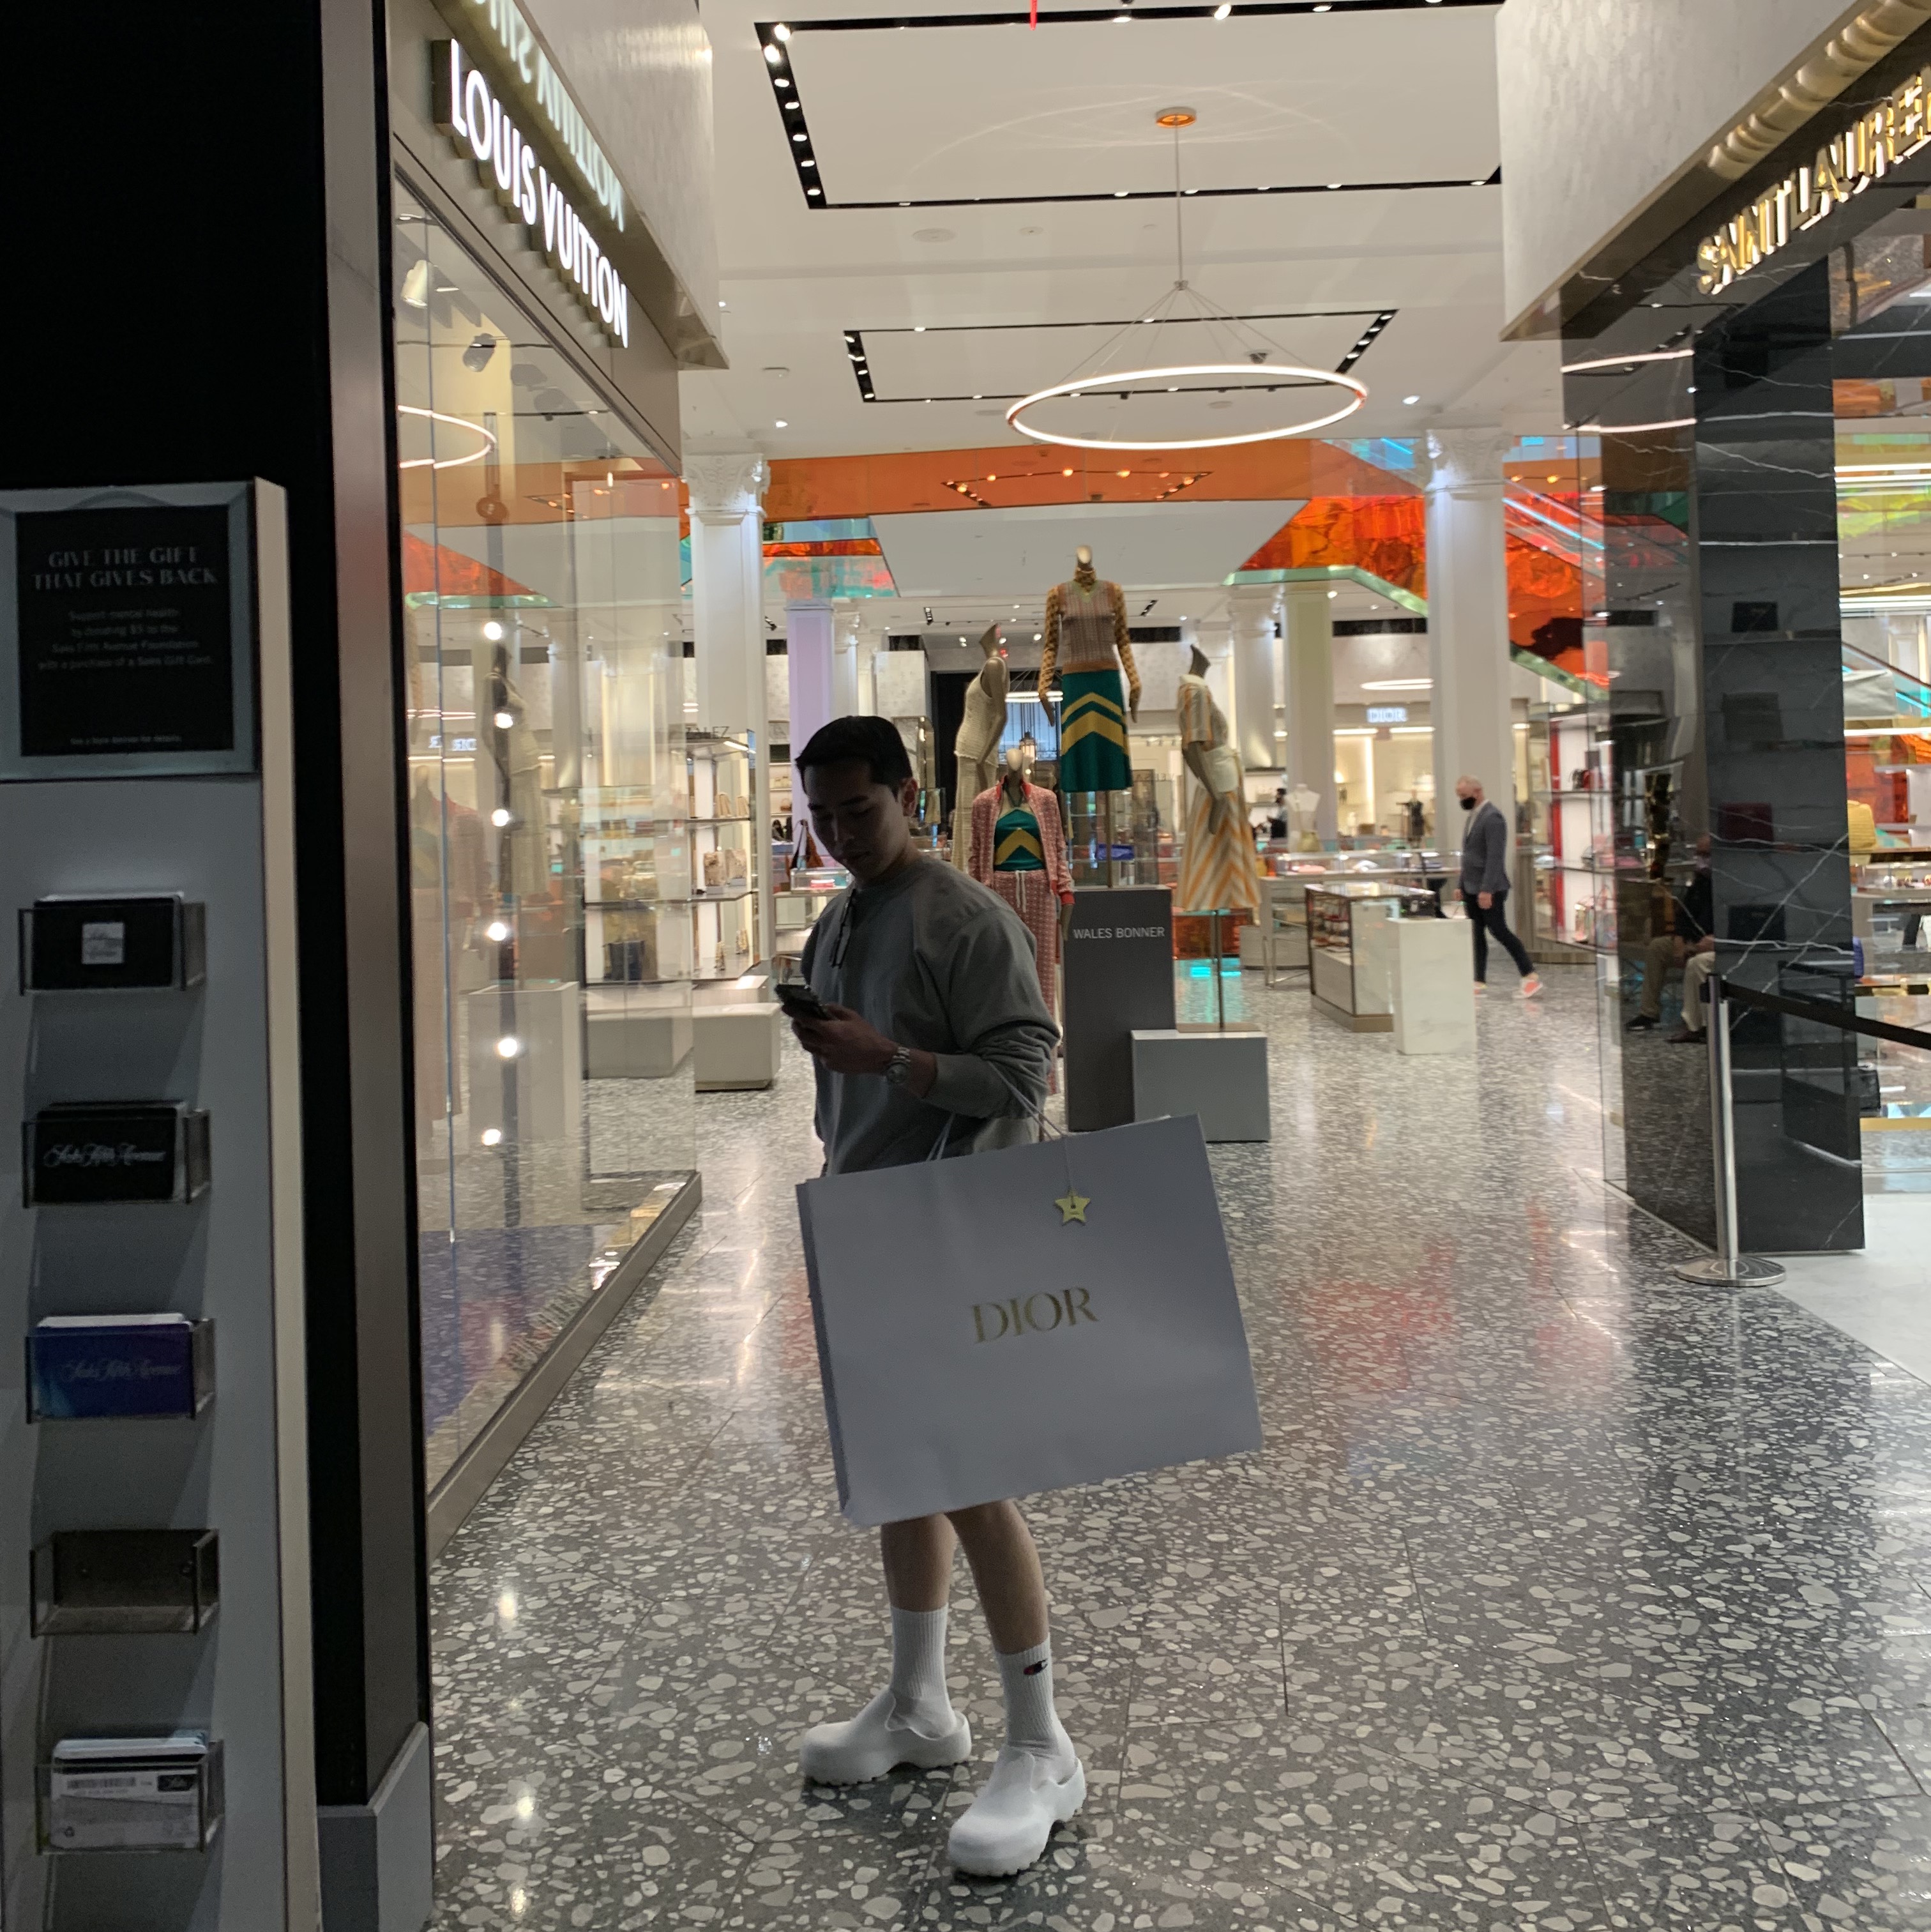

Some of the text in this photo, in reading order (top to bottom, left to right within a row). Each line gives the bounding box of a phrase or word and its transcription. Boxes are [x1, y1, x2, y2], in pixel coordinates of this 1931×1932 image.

[451, 38, 536, 225] LOUIS
[539, 165, 628, 347] VUITTON
[1697, 179, 1792, 294] SAINT
[48, 546, 199, 567] GIVE THE GIFT
[32, 568, 218, 589] THAT GIVES BACK
[1368, 707, 1407, 723] DIOR
[1073, 927, 1165, 939] WALES BONNER
[971, 1286, 1100, 1344] DIOR
